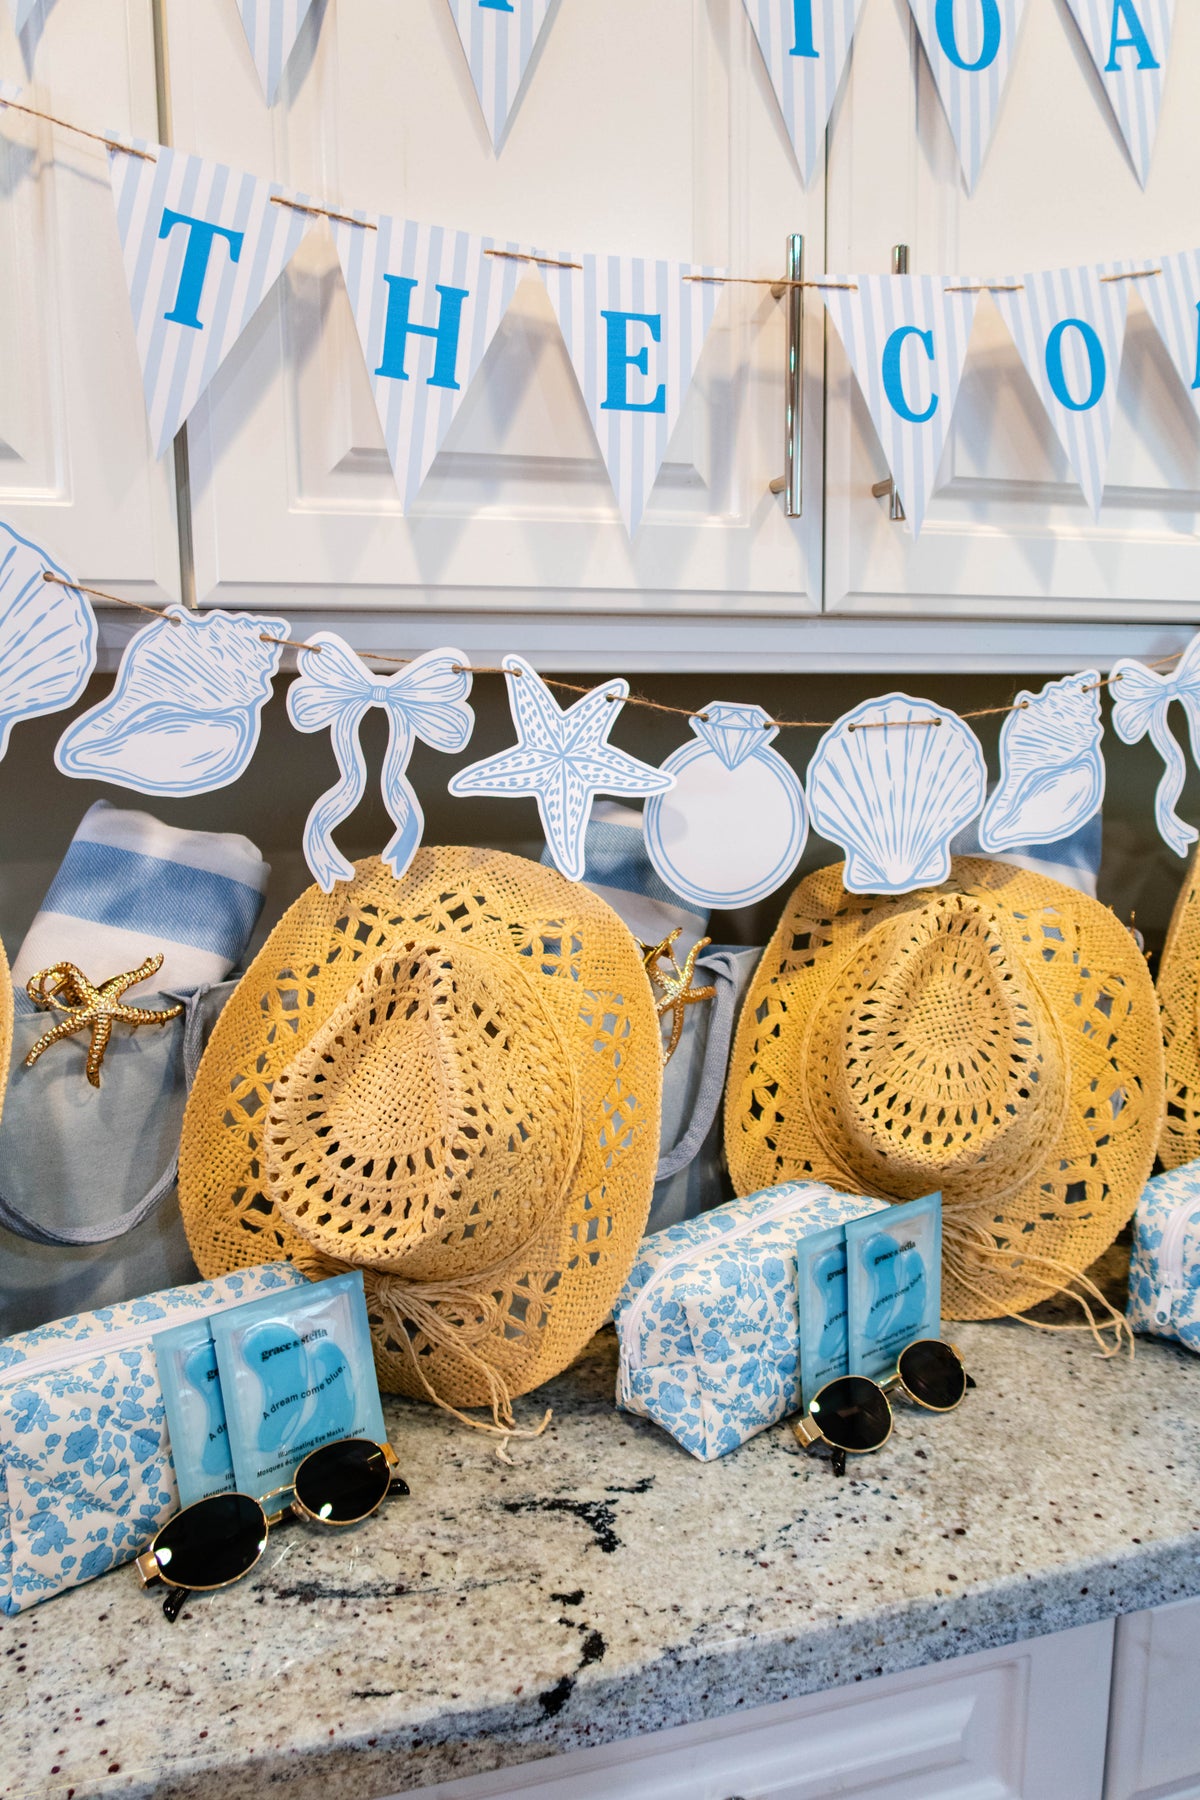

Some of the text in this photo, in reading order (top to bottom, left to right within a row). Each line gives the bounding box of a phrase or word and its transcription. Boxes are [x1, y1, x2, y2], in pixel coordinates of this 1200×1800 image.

[158, 207, 666, 413] THE
[261, 1342, 292, 1362] grace
[300, 1328, 328, 1345] stella
[262, 1365, 346, 1420] A dream come blue.
[208, 1432, 217, 1442] A
